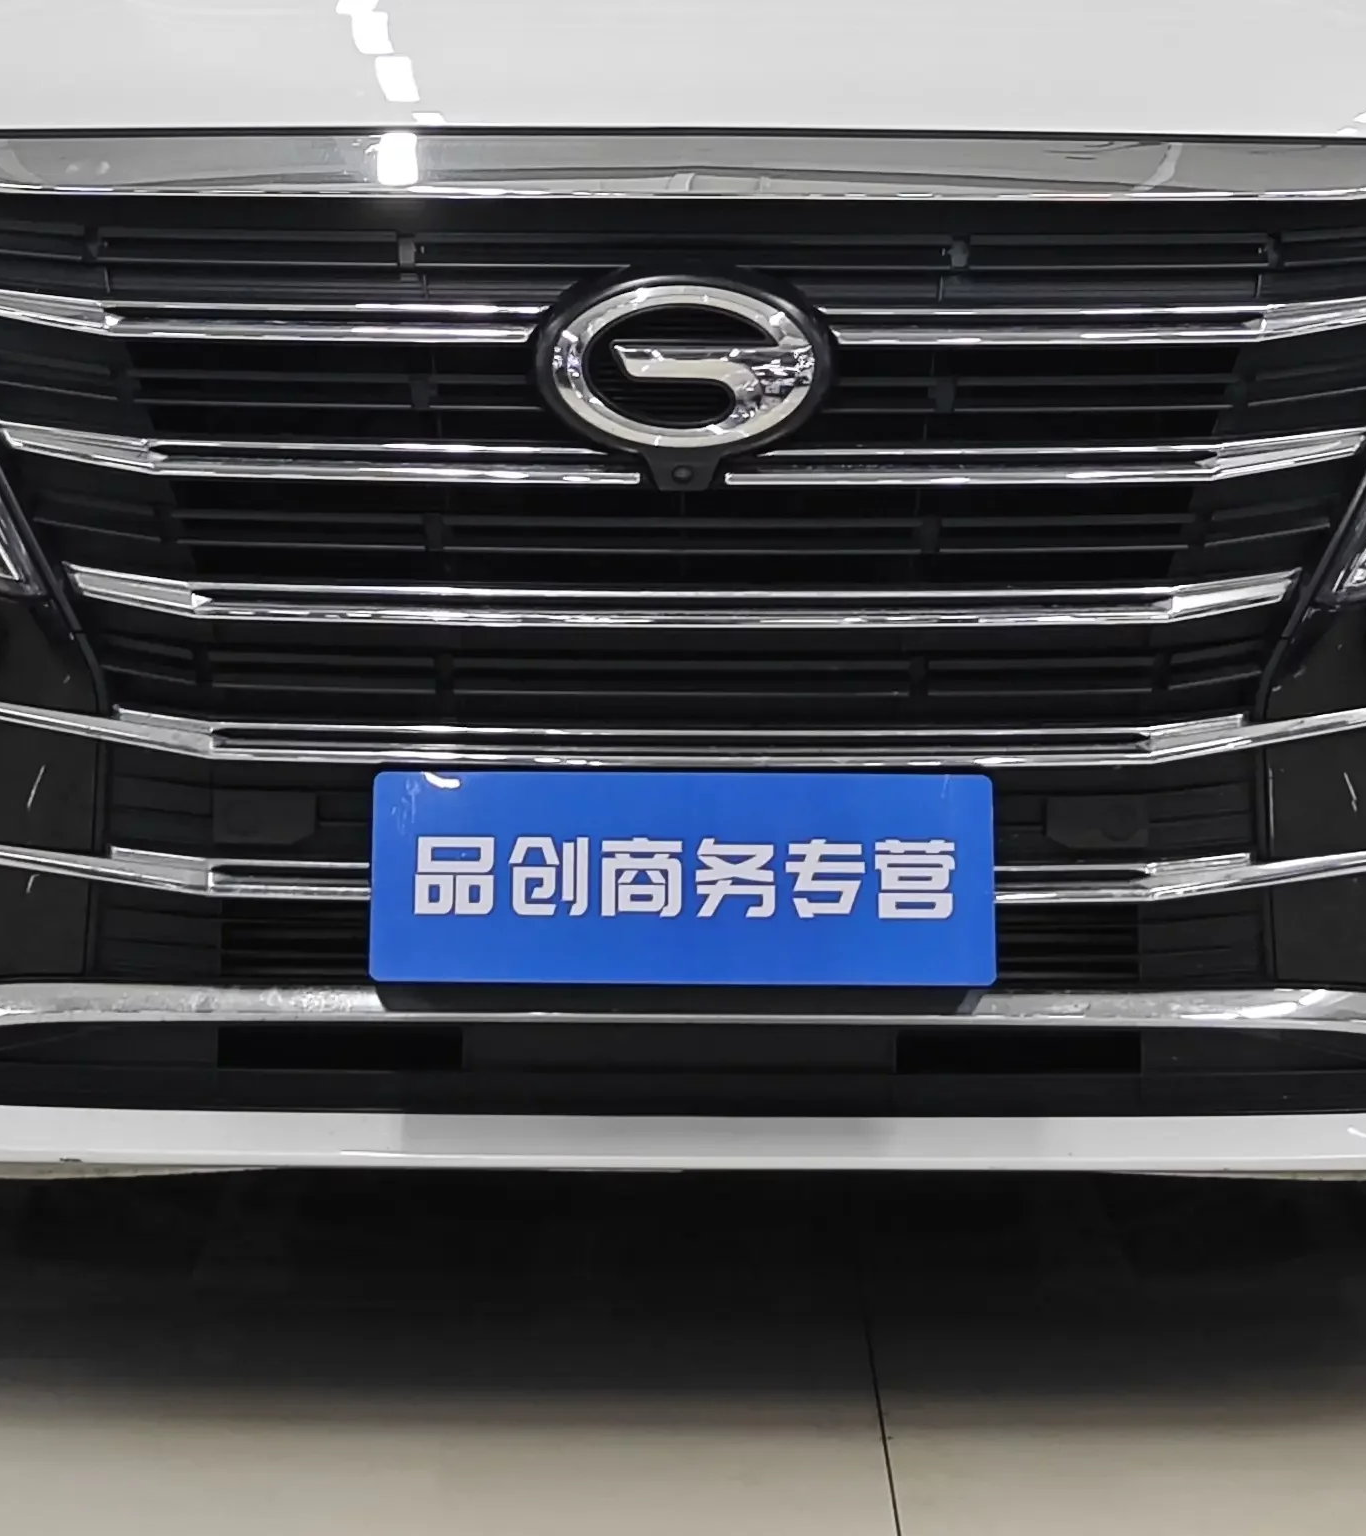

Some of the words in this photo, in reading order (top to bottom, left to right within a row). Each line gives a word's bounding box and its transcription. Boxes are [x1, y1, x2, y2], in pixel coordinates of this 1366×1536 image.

[413, 835, 956, 919] 品创商务专营
